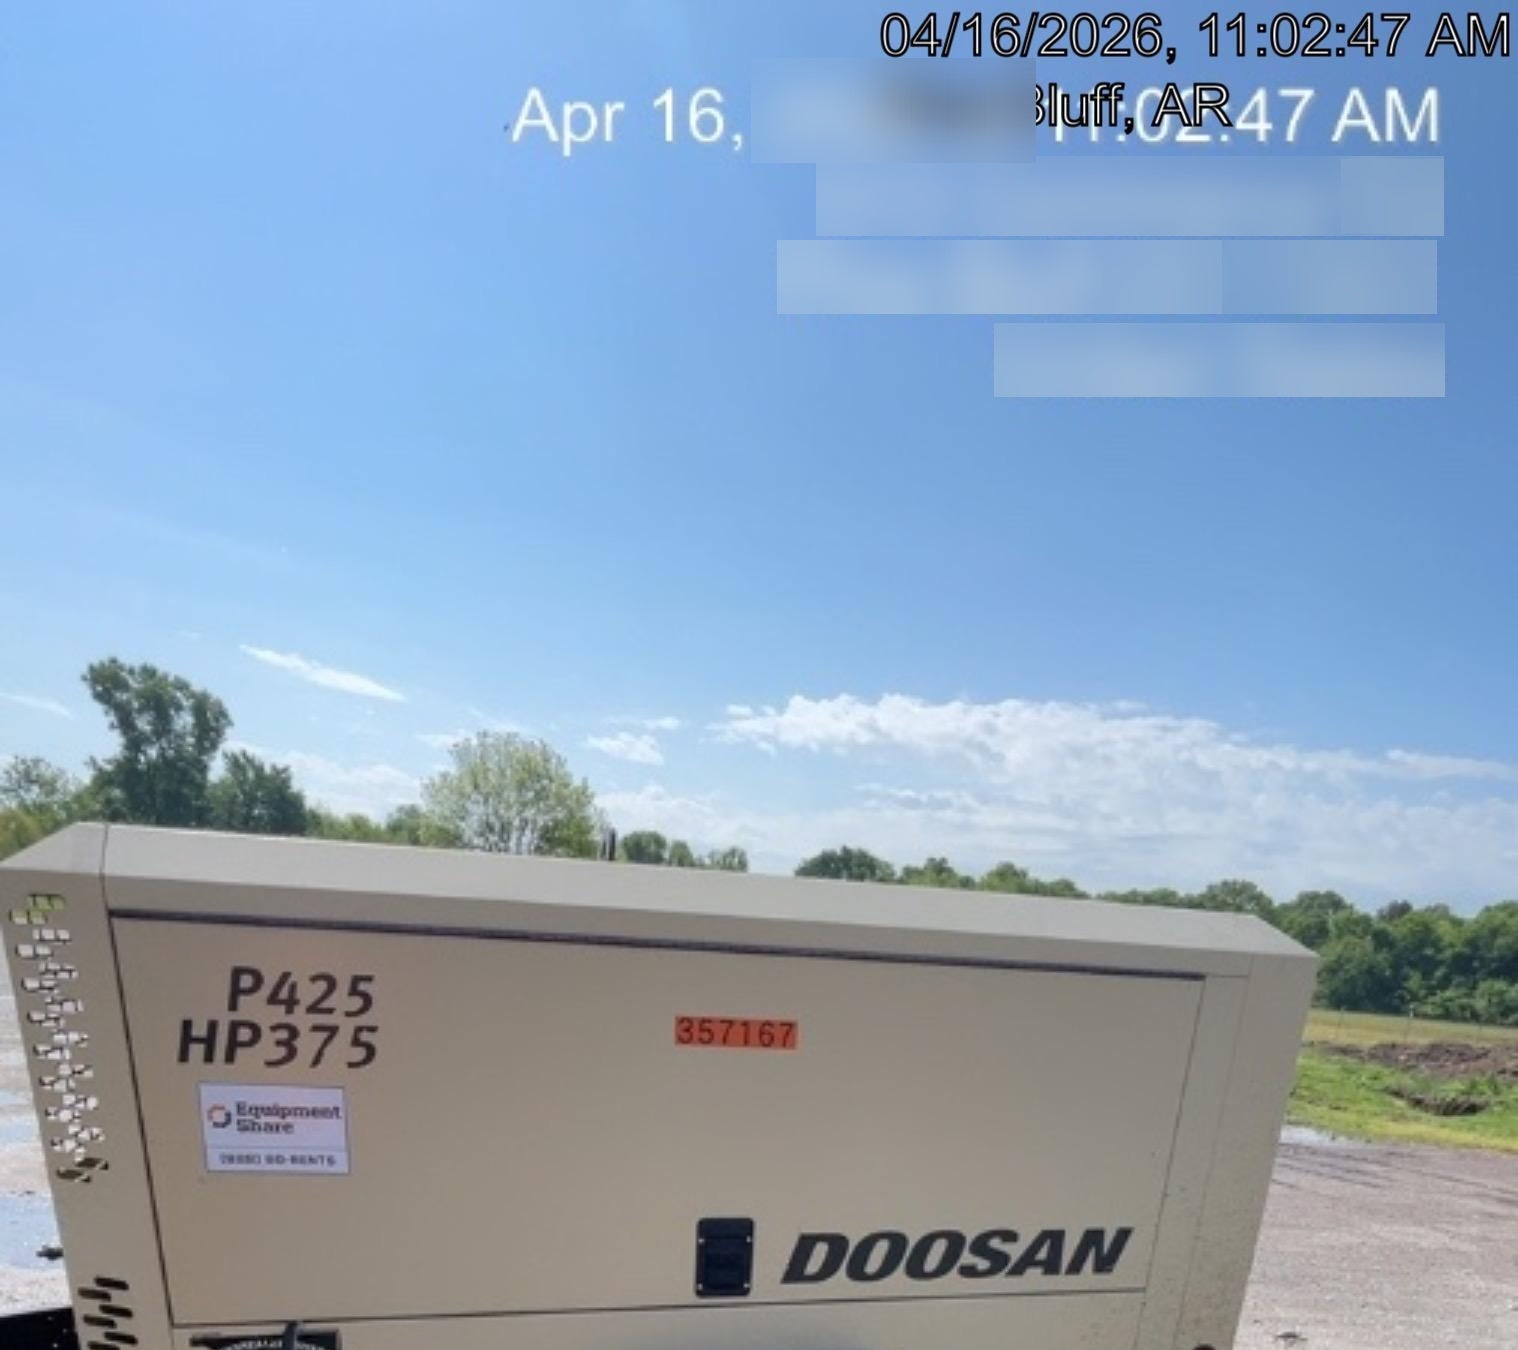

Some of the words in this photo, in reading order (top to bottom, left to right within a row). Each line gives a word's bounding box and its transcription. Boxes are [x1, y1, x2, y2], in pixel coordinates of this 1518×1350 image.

[227, 965, 375, 1018] P425
[177, 1019, 379, 1069] HP375
[677, 1016, 794, 1048] 357167
[235, 1101, 342, 1120] Equipment
[780, 1227, 1135, 1284] DOOSAN
